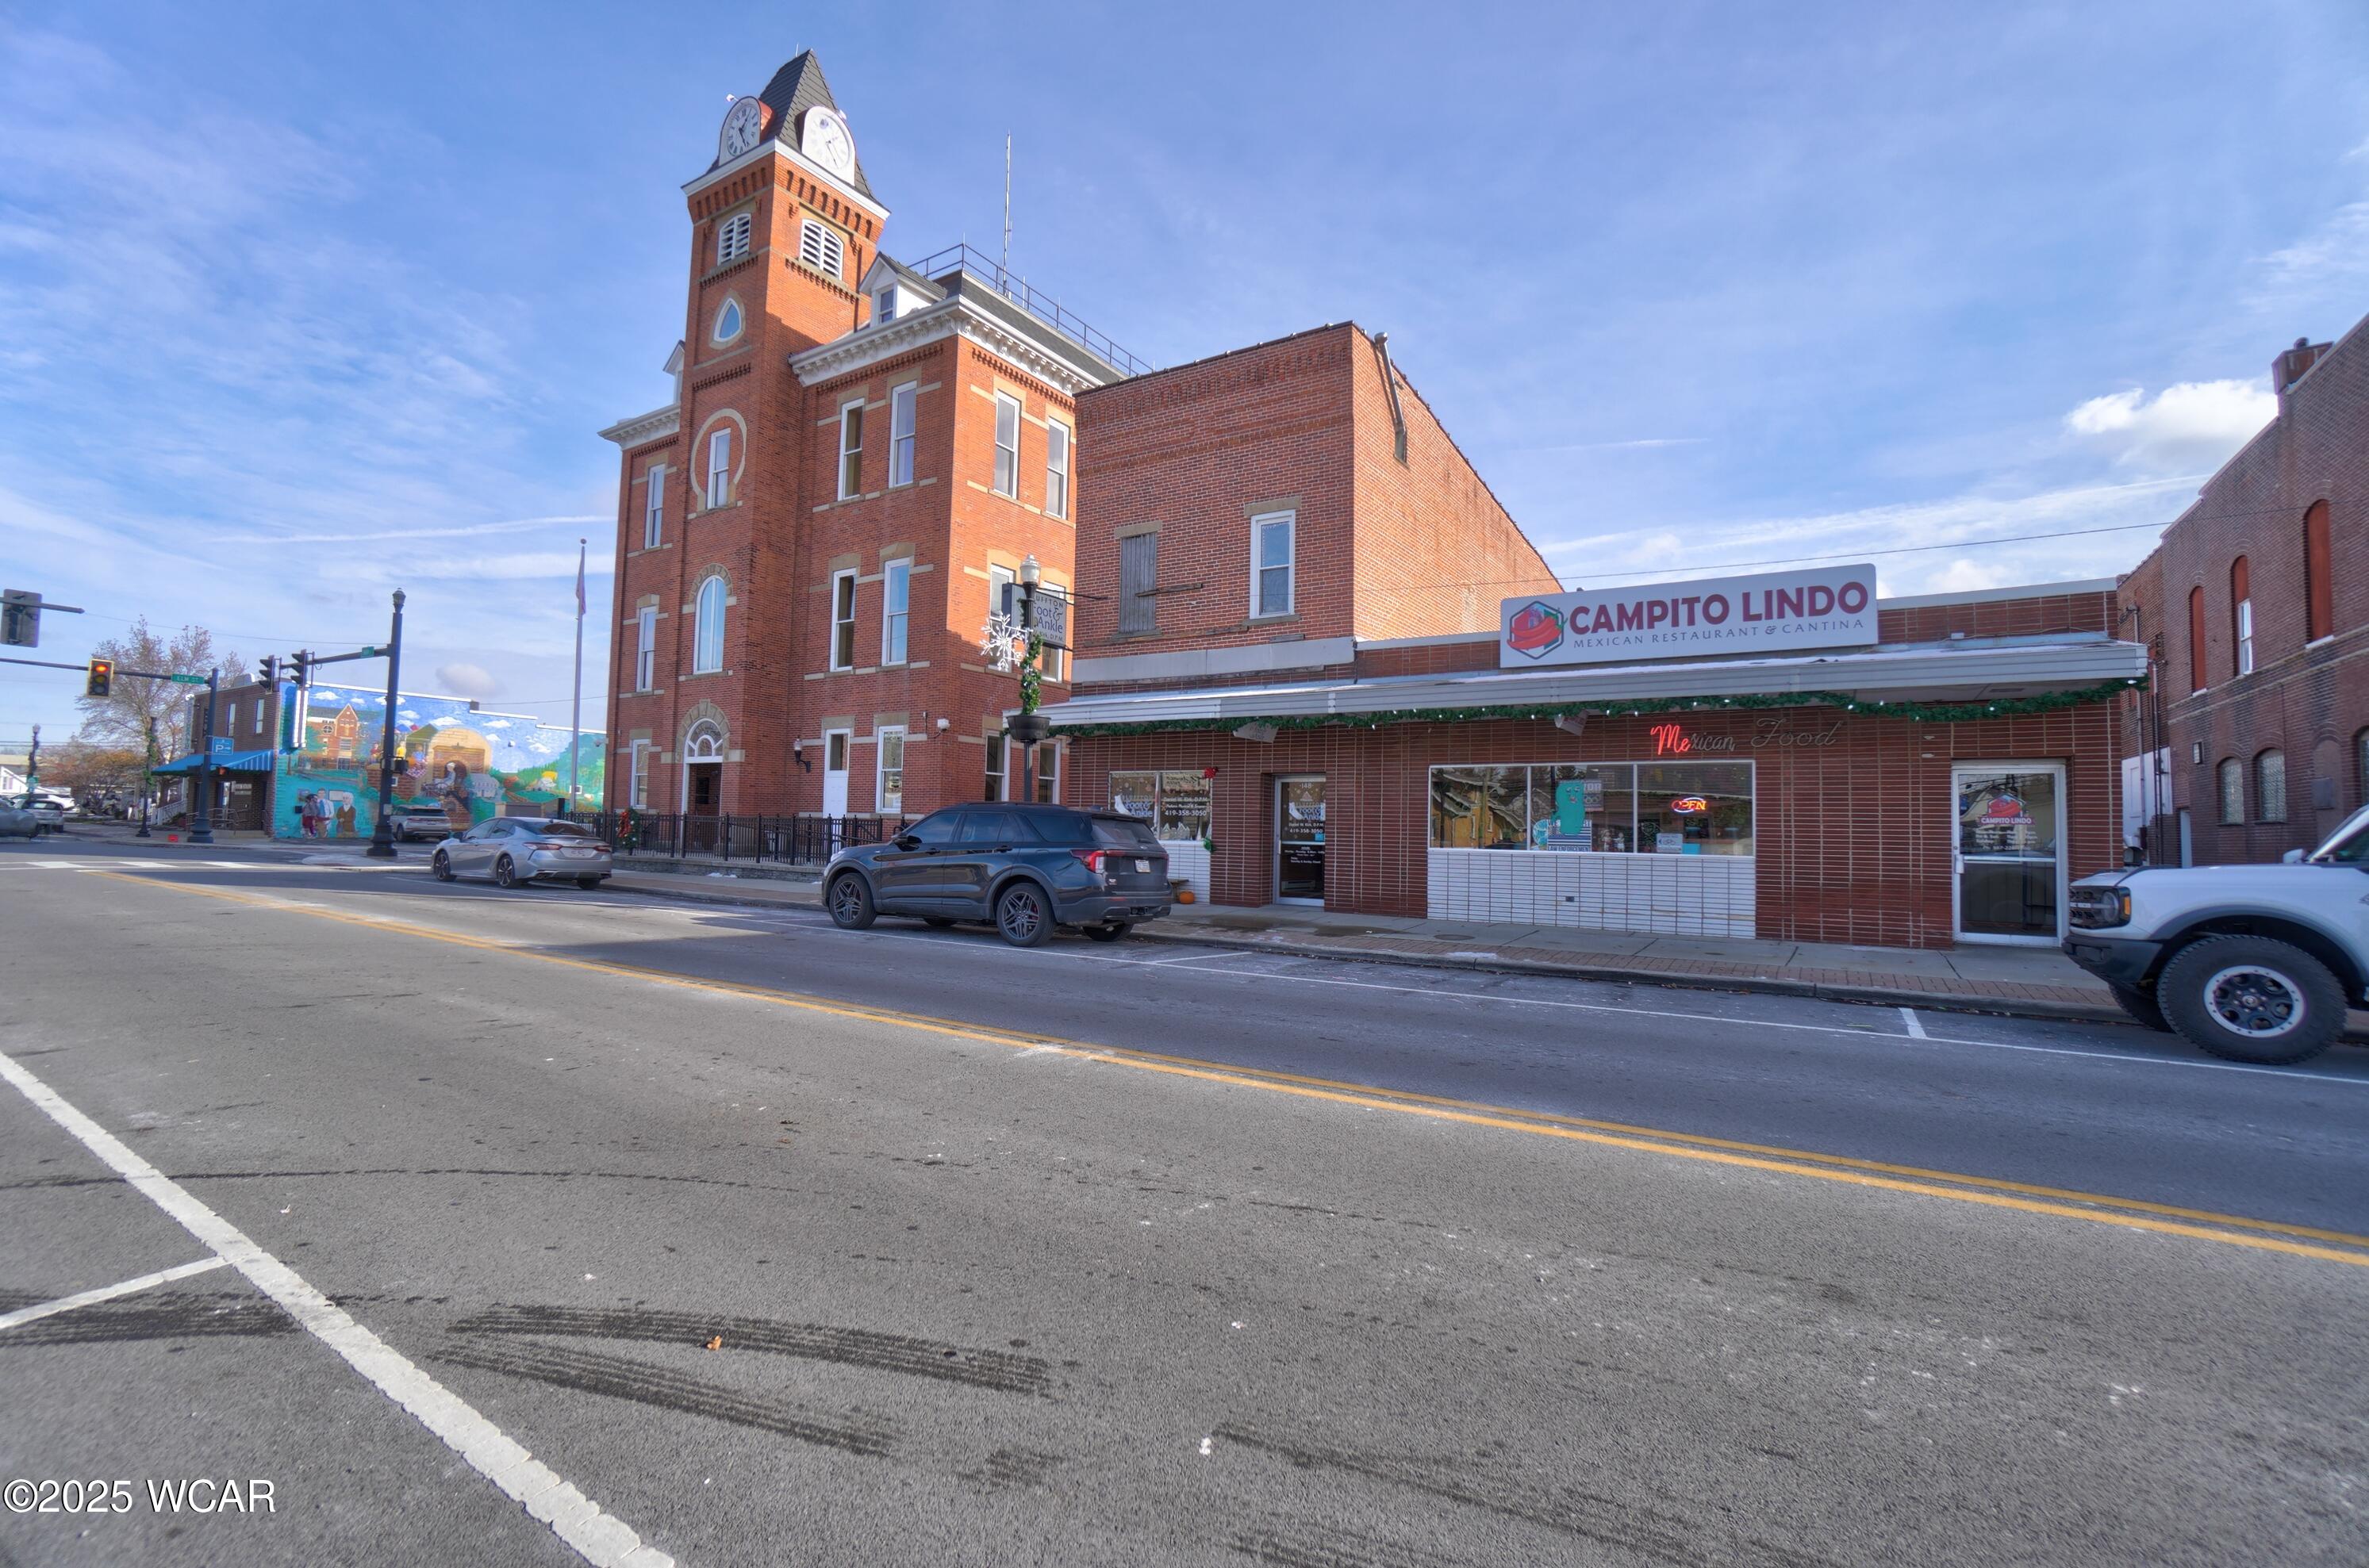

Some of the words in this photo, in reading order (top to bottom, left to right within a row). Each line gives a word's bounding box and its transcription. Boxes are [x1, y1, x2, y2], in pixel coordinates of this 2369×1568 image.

[1569, 593, 1730, 634] CAMPITO
[1741, 581, 1868, 623] LINDO
[1038, 616, 1063, 633] Ankle
[1573, 636, 1644, 649] MEXICAN
[1652, 627, 1758, 642] RESTAURANT
[1764, 625, 1778, 635] &
[1782, 619, 1864, 634] CANTINA
[1650, 723, 1736, 755] Mexican
[1751, 718, 1843, 748] Food
[215, 744, 224, 753] P
[1672, 800, 1707, 811] OPEN
